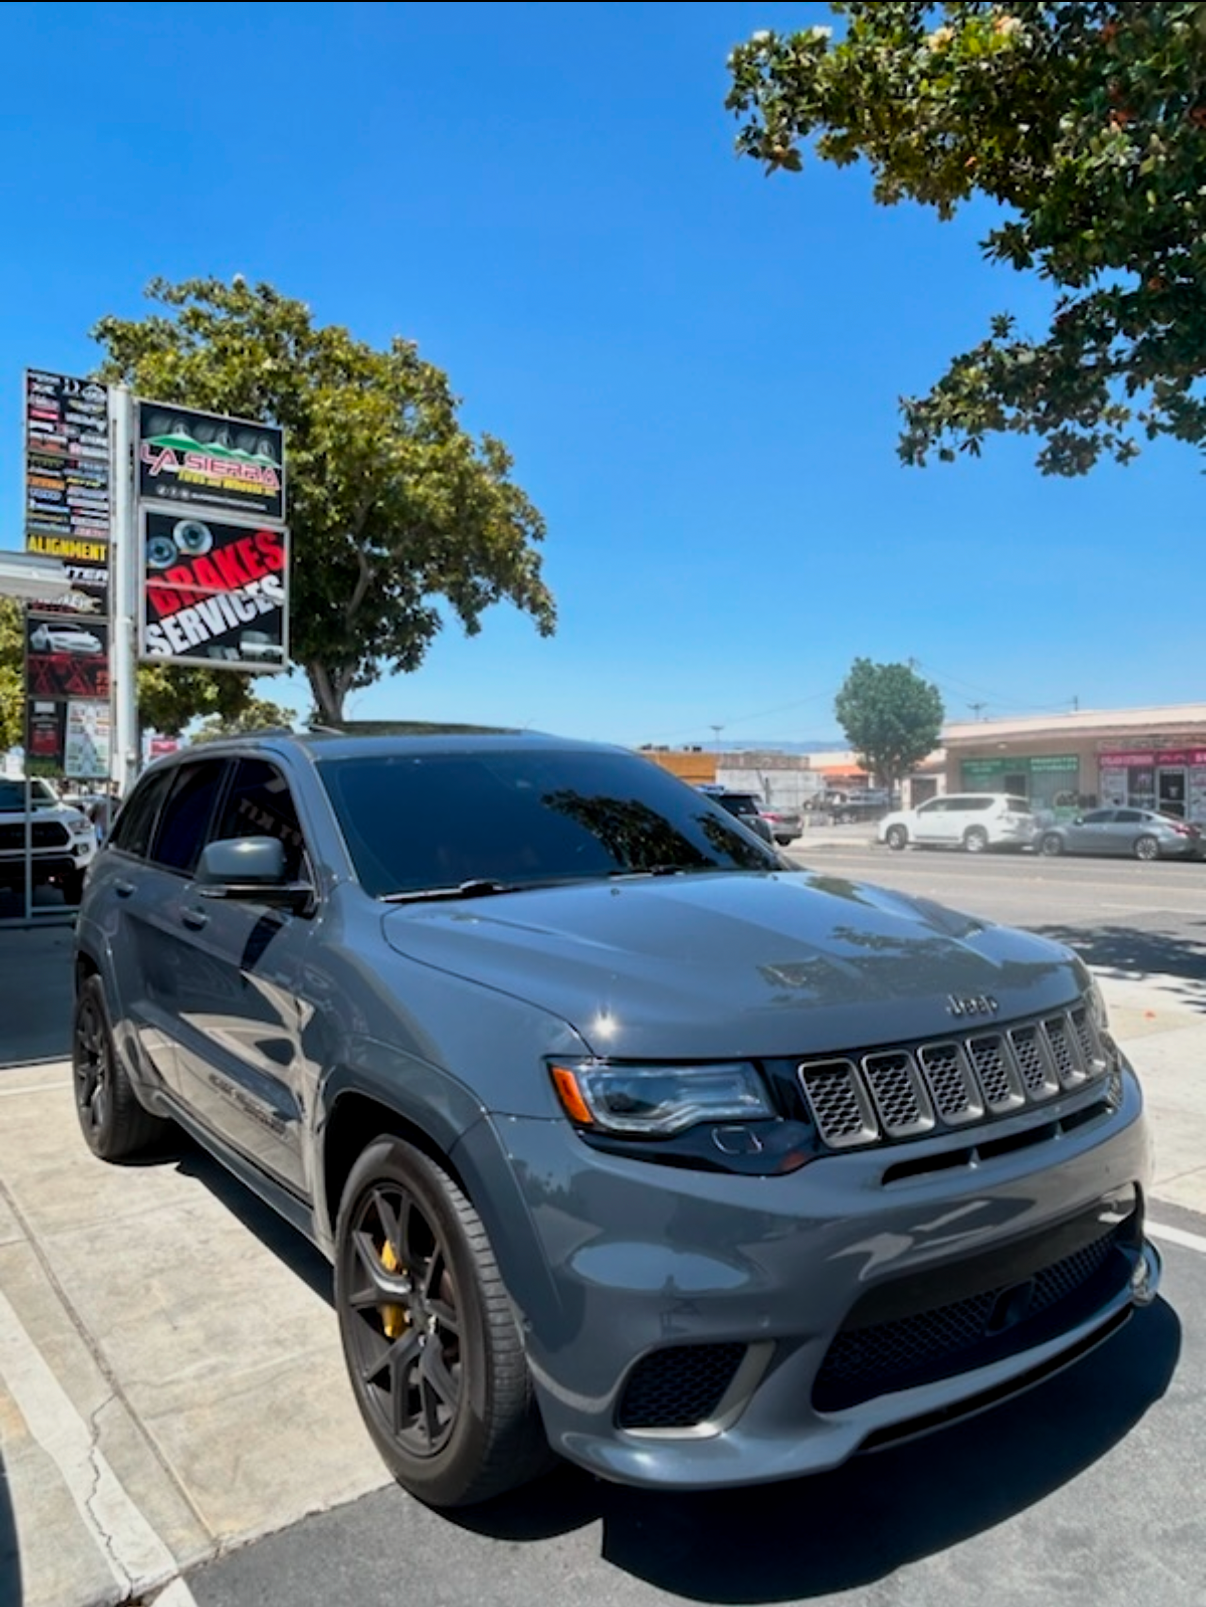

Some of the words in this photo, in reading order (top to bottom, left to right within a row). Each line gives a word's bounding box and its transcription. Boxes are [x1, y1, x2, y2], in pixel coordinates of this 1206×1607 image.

[140, 443, 178, 476] LA
[184, 452, 281, 490] SIERRA
[28, 534, 106, 561] ALIGNMENT
[146, 530, 285, 618] BRAKES
[146, 575, 284, 656] SERVICES
[945, 994, 998, 1018] Jeep
